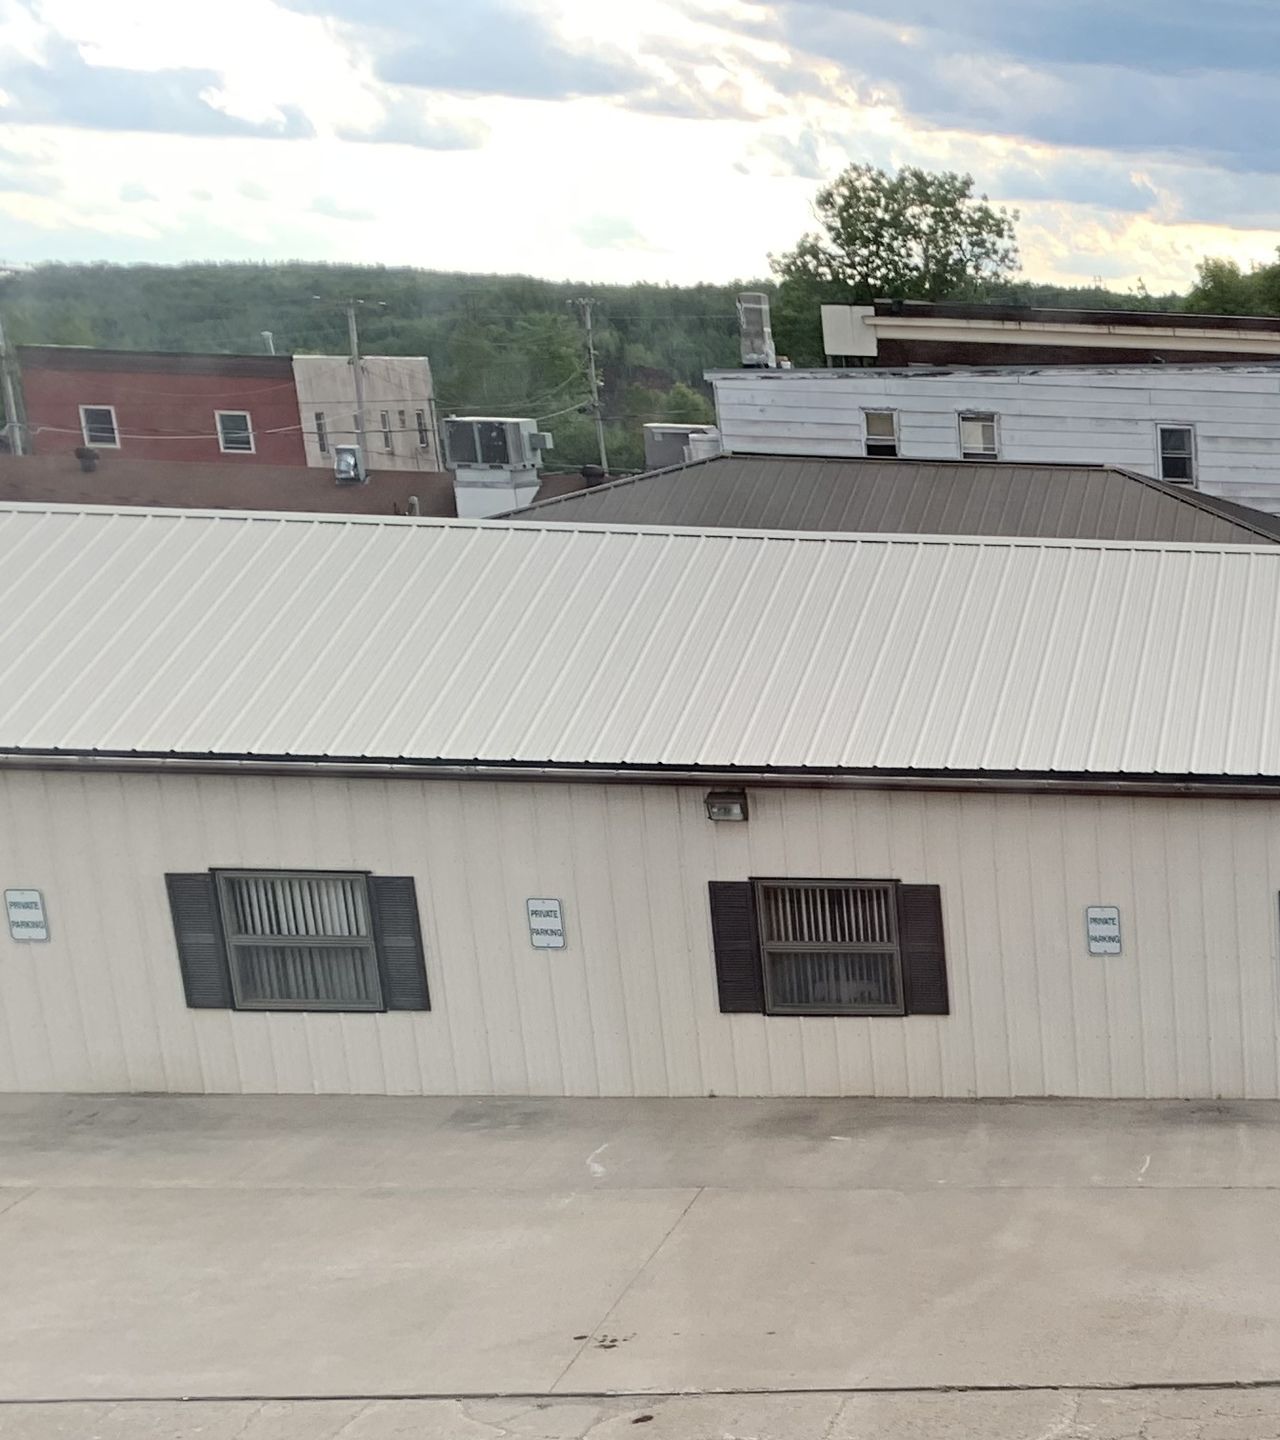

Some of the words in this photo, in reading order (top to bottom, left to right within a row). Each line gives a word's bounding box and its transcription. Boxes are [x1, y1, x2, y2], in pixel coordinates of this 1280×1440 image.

[8, 901, 40, 910] PRIVATE
[531, 910, 559, 918] PRIVATE
[11, 920, 46, 928] PARKING
[1090, 917, 1117, 926] PRIVATE
[531, 928, 562, 936] PARKING
[1090, 935, 1120, 943] PARKING
